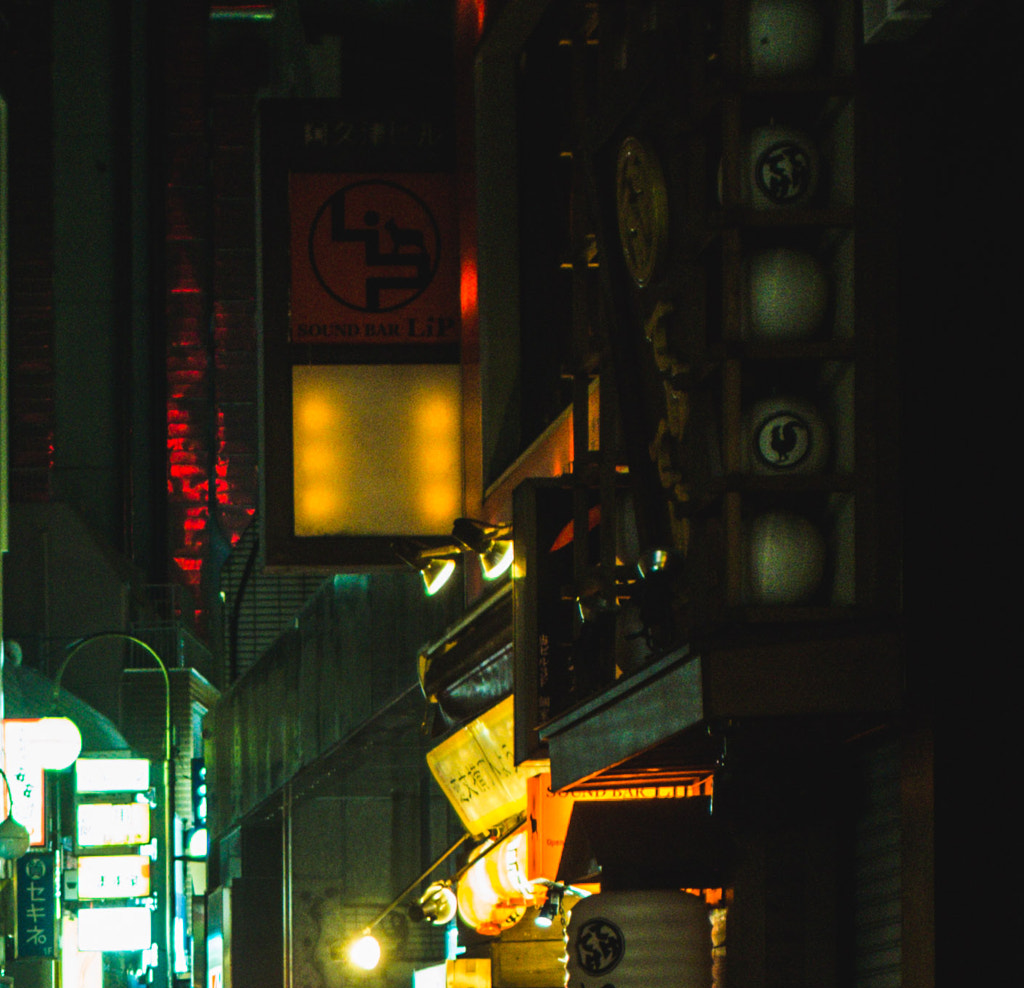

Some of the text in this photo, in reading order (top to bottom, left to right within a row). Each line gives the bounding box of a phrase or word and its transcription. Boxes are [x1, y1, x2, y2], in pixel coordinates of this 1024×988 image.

[296, 317, 455, 337] SOUND BAR LiP
[26, 881, 47, 946] セキネ
